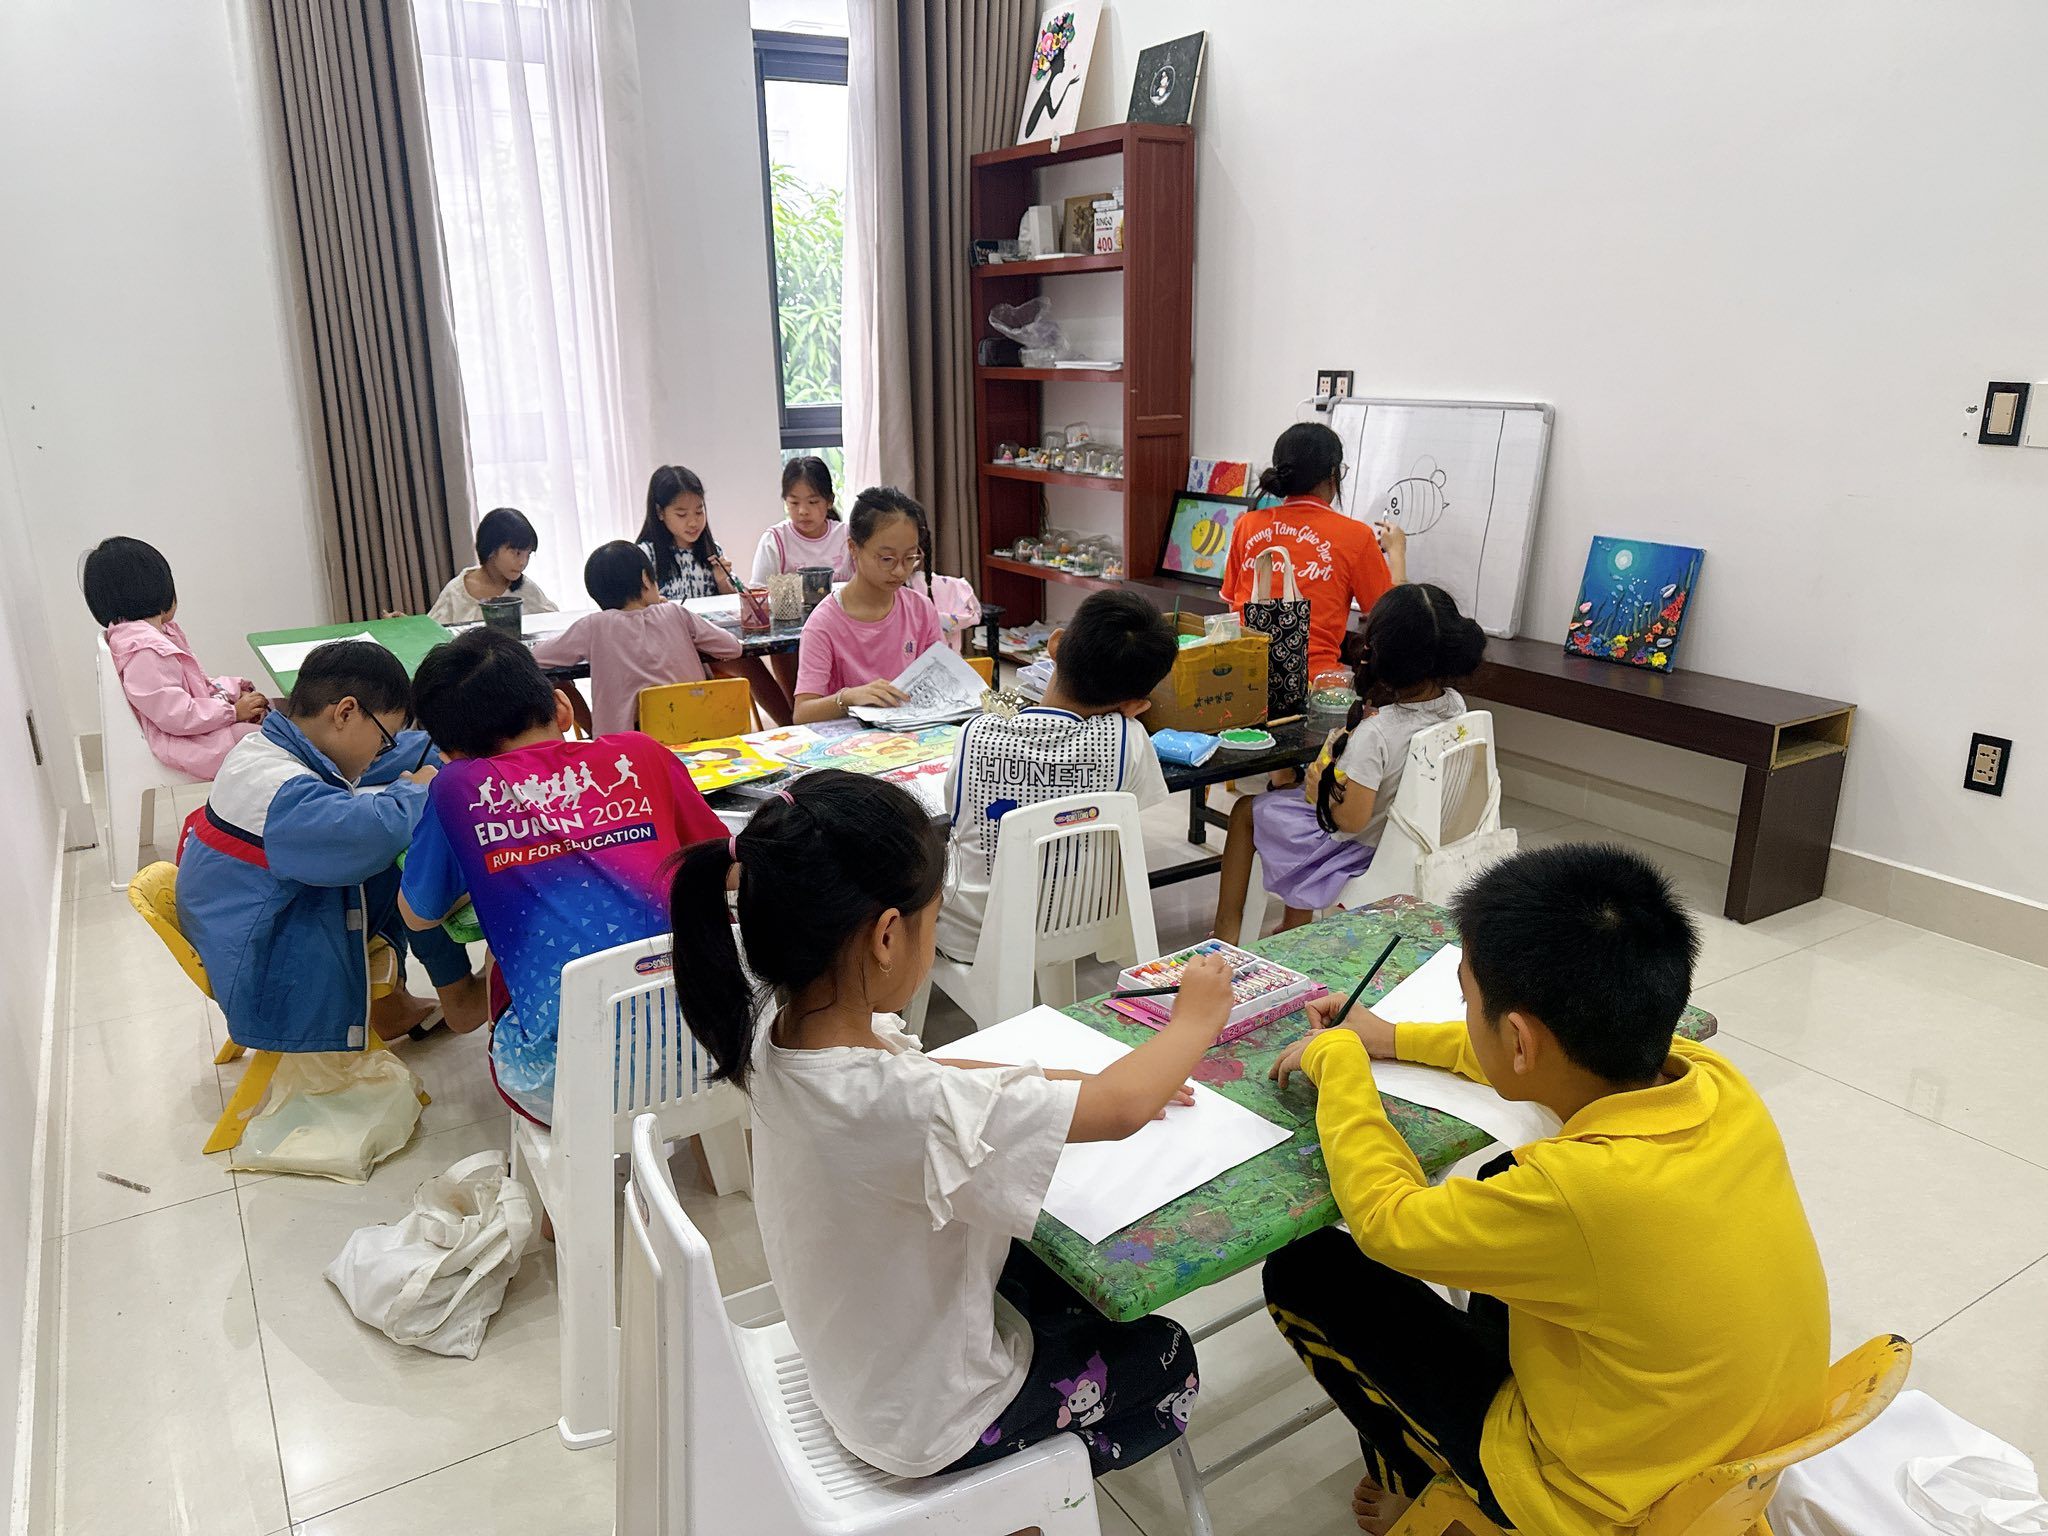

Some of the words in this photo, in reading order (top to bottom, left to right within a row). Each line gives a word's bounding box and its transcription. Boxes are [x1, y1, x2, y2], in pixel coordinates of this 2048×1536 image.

[1096, 236, 1113, 252] 400
[1297, 561, 1333, 581] Art
[979, 756, 1097, 788] HUNET
[474, 813, 585, 847] EDURUN
[588, 796, 653, 827] 2024
[492, 851, 523, 868] RUN
[528, 843, 561, 861] FOR
